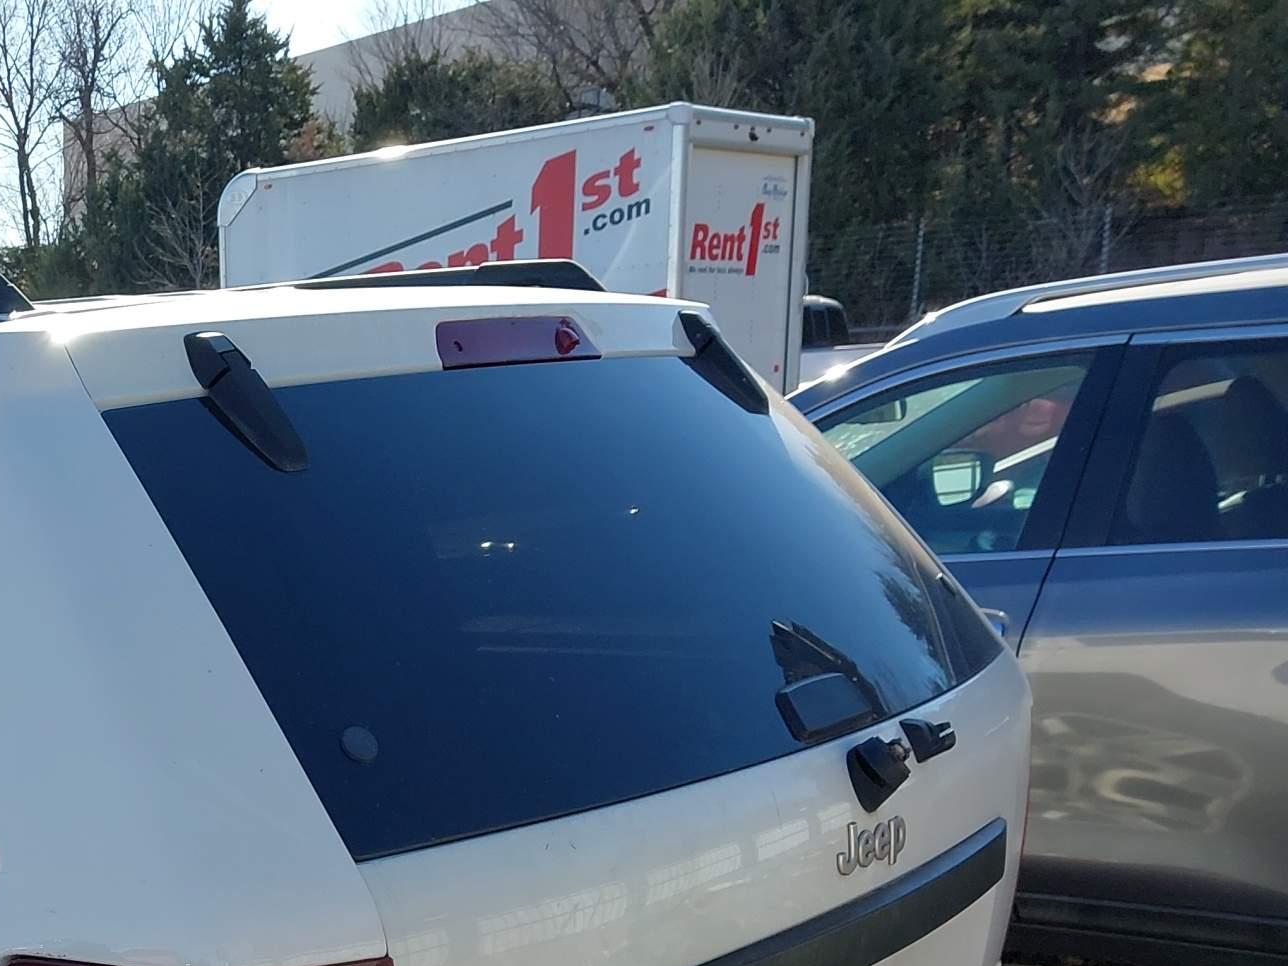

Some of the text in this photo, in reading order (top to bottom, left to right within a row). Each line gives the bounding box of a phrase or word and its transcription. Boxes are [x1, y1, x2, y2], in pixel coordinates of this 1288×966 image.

[583, 196, 650, 235] .com
[690, 223, 745, 262] Rent
[836, 815, 906, 876] Jeep
